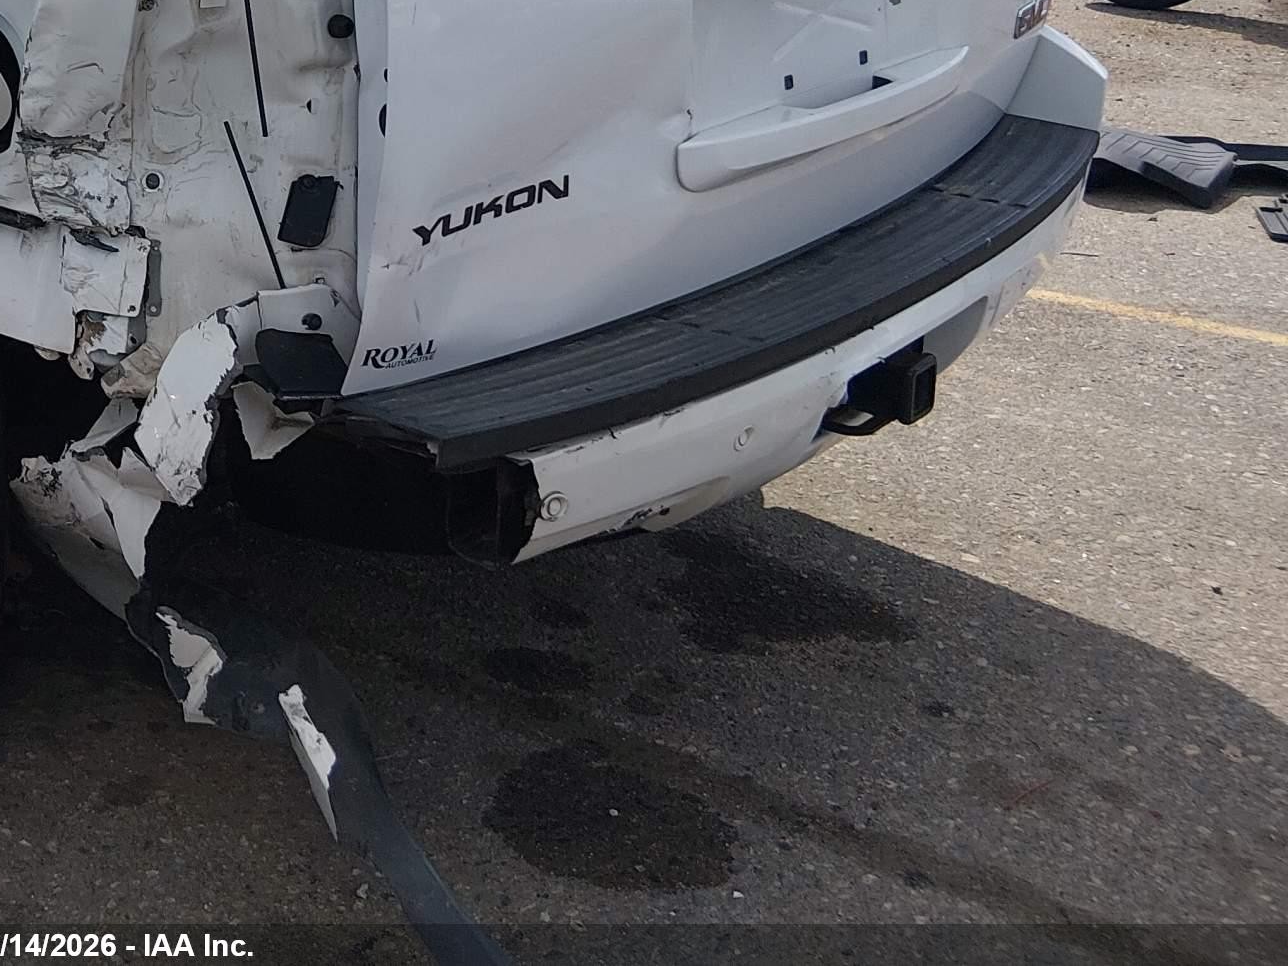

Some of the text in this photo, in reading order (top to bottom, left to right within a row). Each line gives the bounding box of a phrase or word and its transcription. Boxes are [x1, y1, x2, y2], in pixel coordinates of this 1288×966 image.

[412, 174, 570, 247] YUKON
[360, 339, 437, 369] ROYAL
[384, 353, 435, 370] AUTOMOTIVE
